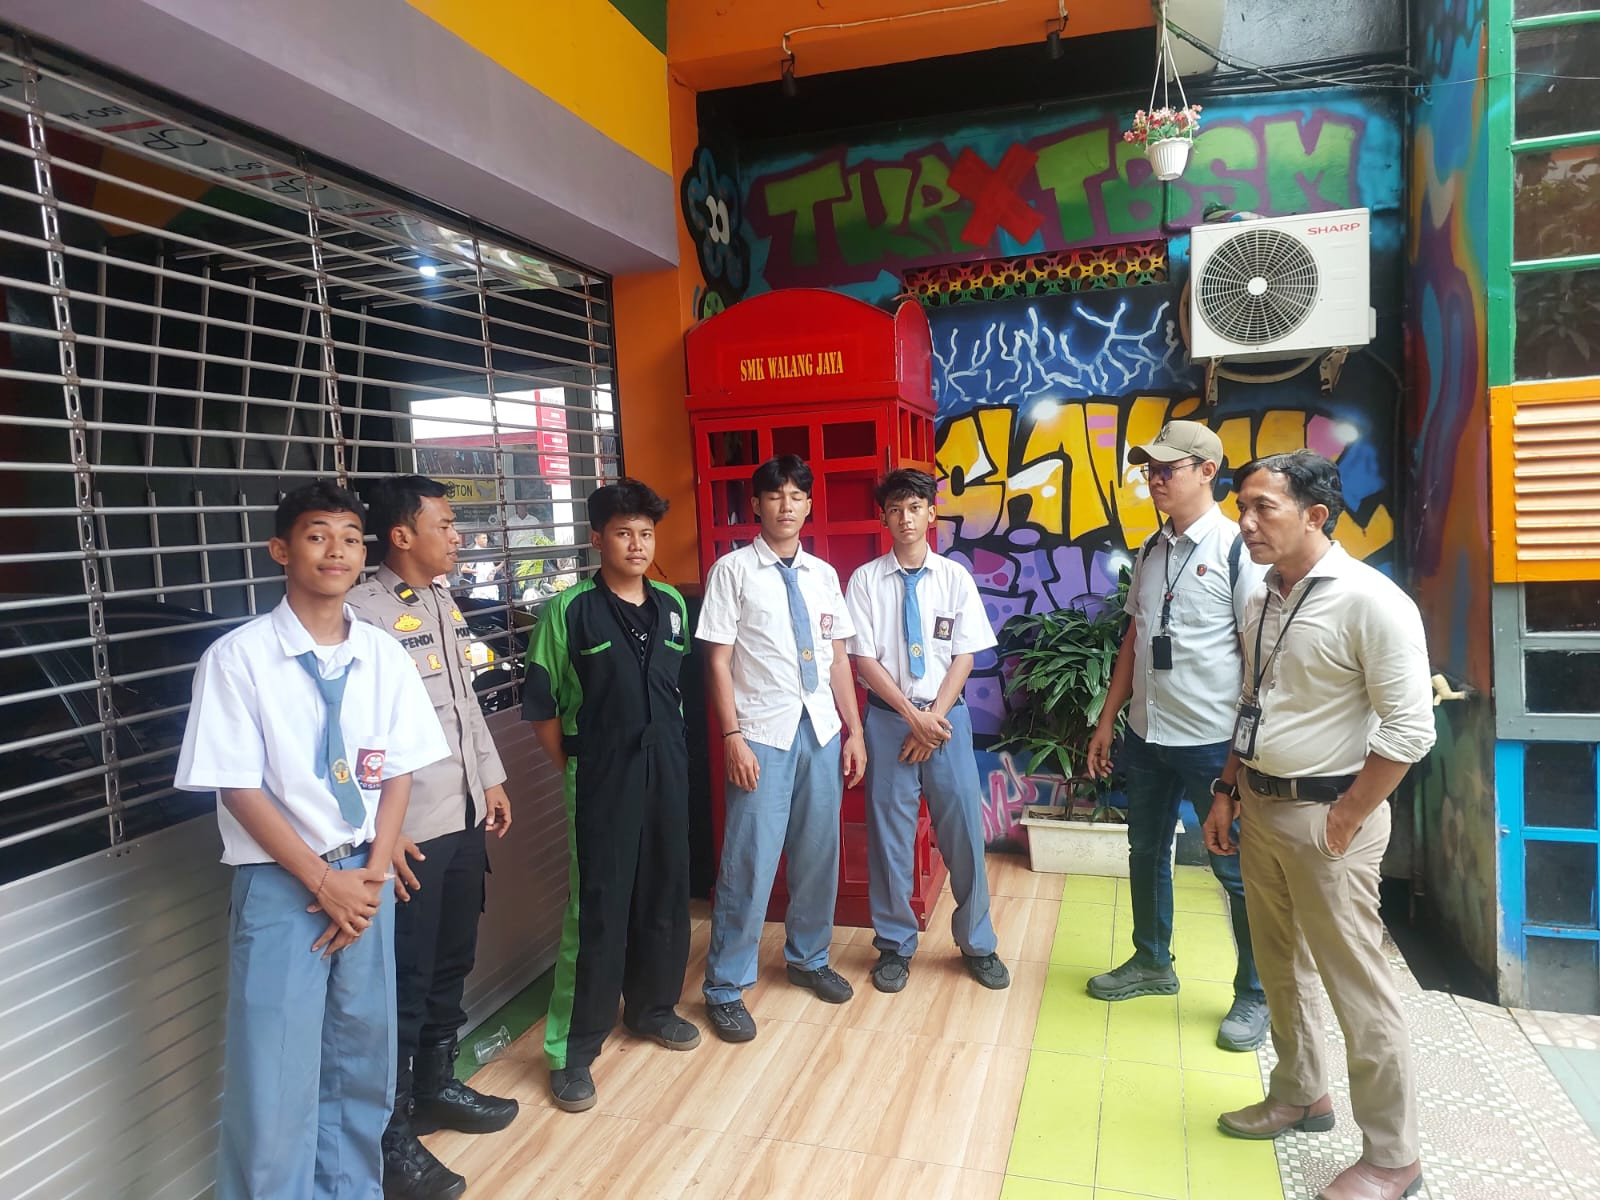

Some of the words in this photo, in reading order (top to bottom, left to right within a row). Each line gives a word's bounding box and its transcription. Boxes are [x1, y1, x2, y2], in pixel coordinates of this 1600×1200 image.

[1035, 118, 1356, 245] TBSM
[1307, 222, 1361, 236] SHARP
[740, 358, 765, 382] SMK
[767, 353, 813, 379] WALANG
[816, 350, 844, 376] JAYA
